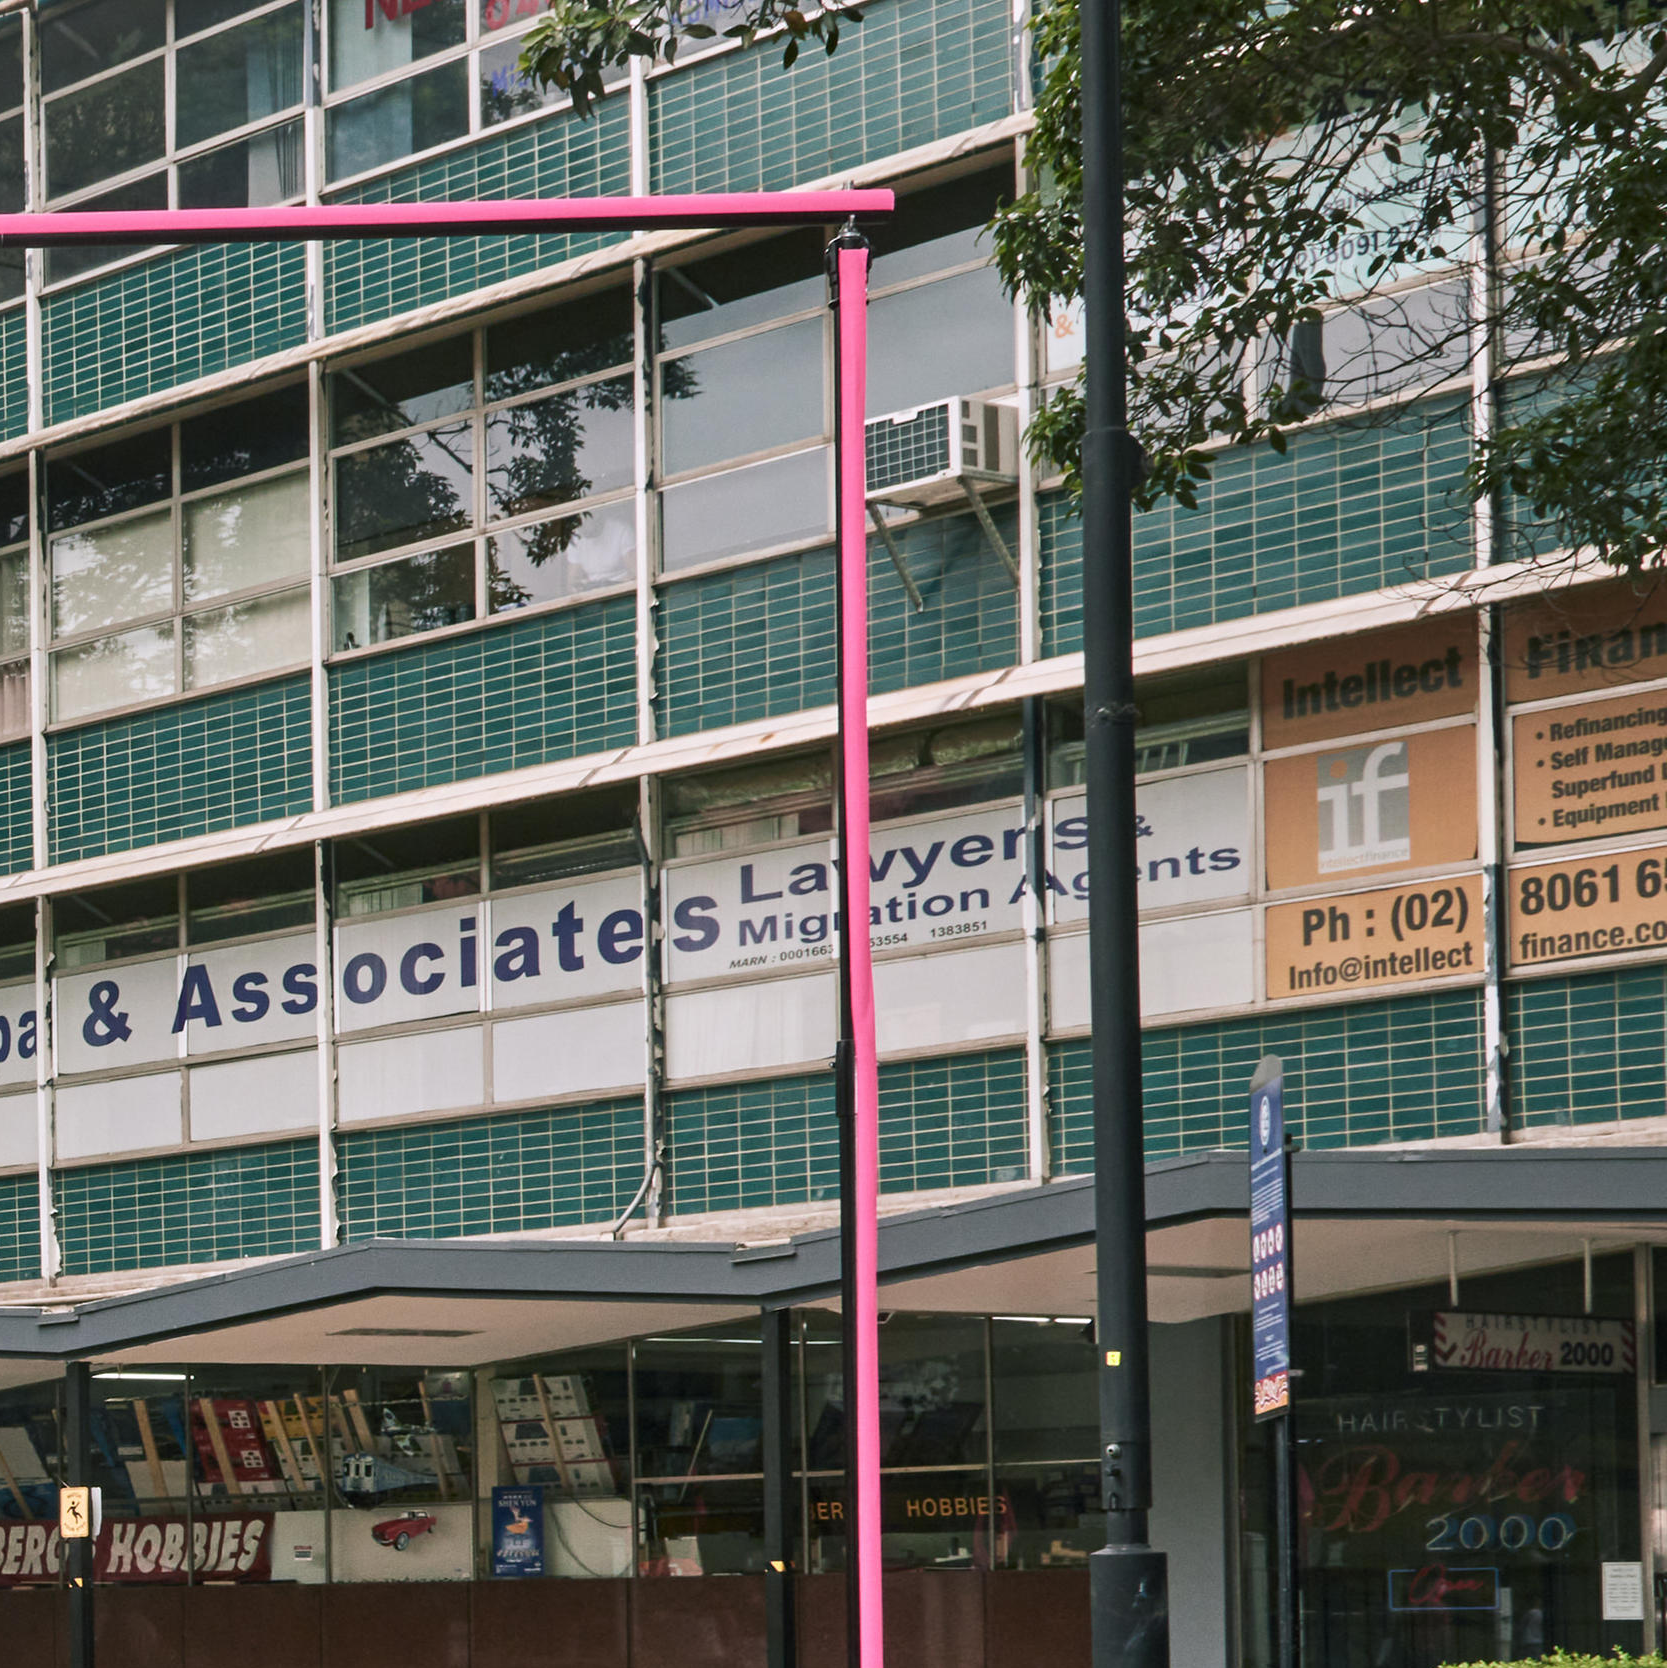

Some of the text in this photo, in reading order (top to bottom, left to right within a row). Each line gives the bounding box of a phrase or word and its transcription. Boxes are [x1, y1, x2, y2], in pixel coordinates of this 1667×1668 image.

[1283, 647, 1464, 720] Intellect
[1551, 750, 1589, 771] Self
[1551, 764, 1655, 800] Superfund
[1552, 792, 1660, 827] Equipment
[1009, 844, 1242, 905] Agnts
[1302, 905, 1350, 947] Ph
[1391, 886, 1469, 942] (02)
[1519, 863, 1620, 917] 8061
[1635, 858, 1667, 903] 6
[171, 895, 720, 1035] Associates
[729, 954, 768, 970] MARN
[930, 920, 989, 940] 1383851
[1289, 941, 1474, 991] Info@intellect
[82, 979, 133, 1048] &
[1466, 1315, 1603, 1335] HAIRSTYLIST
[1560, 1341, 1613, 1367] 2000
[1337, 1406, 1546, 1433] HAIRSTYLIST
[906, 1496, 1008, 1518] HOBBIES
[106, 1519, 266, 1574] HOBBIES
[1426, 1511, 1576, 1551] 2000
